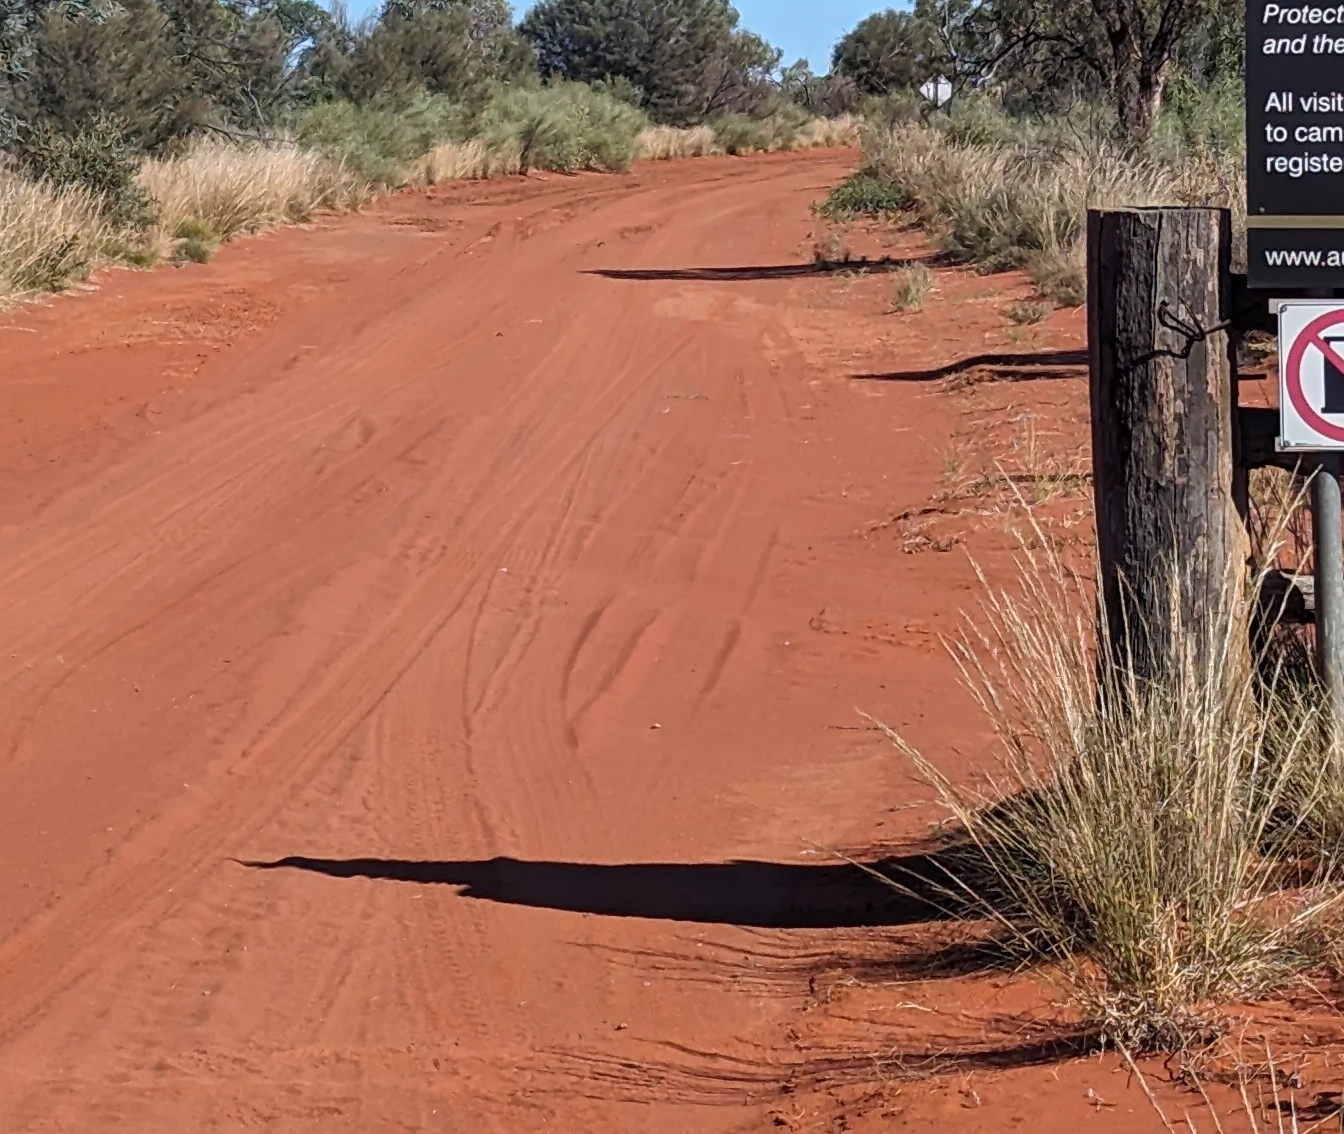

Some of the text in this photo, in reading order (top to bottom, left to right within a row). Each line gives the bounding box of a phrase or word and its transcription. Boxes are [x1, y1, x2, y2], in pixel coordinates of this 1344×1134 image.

[1262, 33, 1307, 55] and
[1264, 91, 1293, 112] All
[1264, 123, 1288, 143] to
